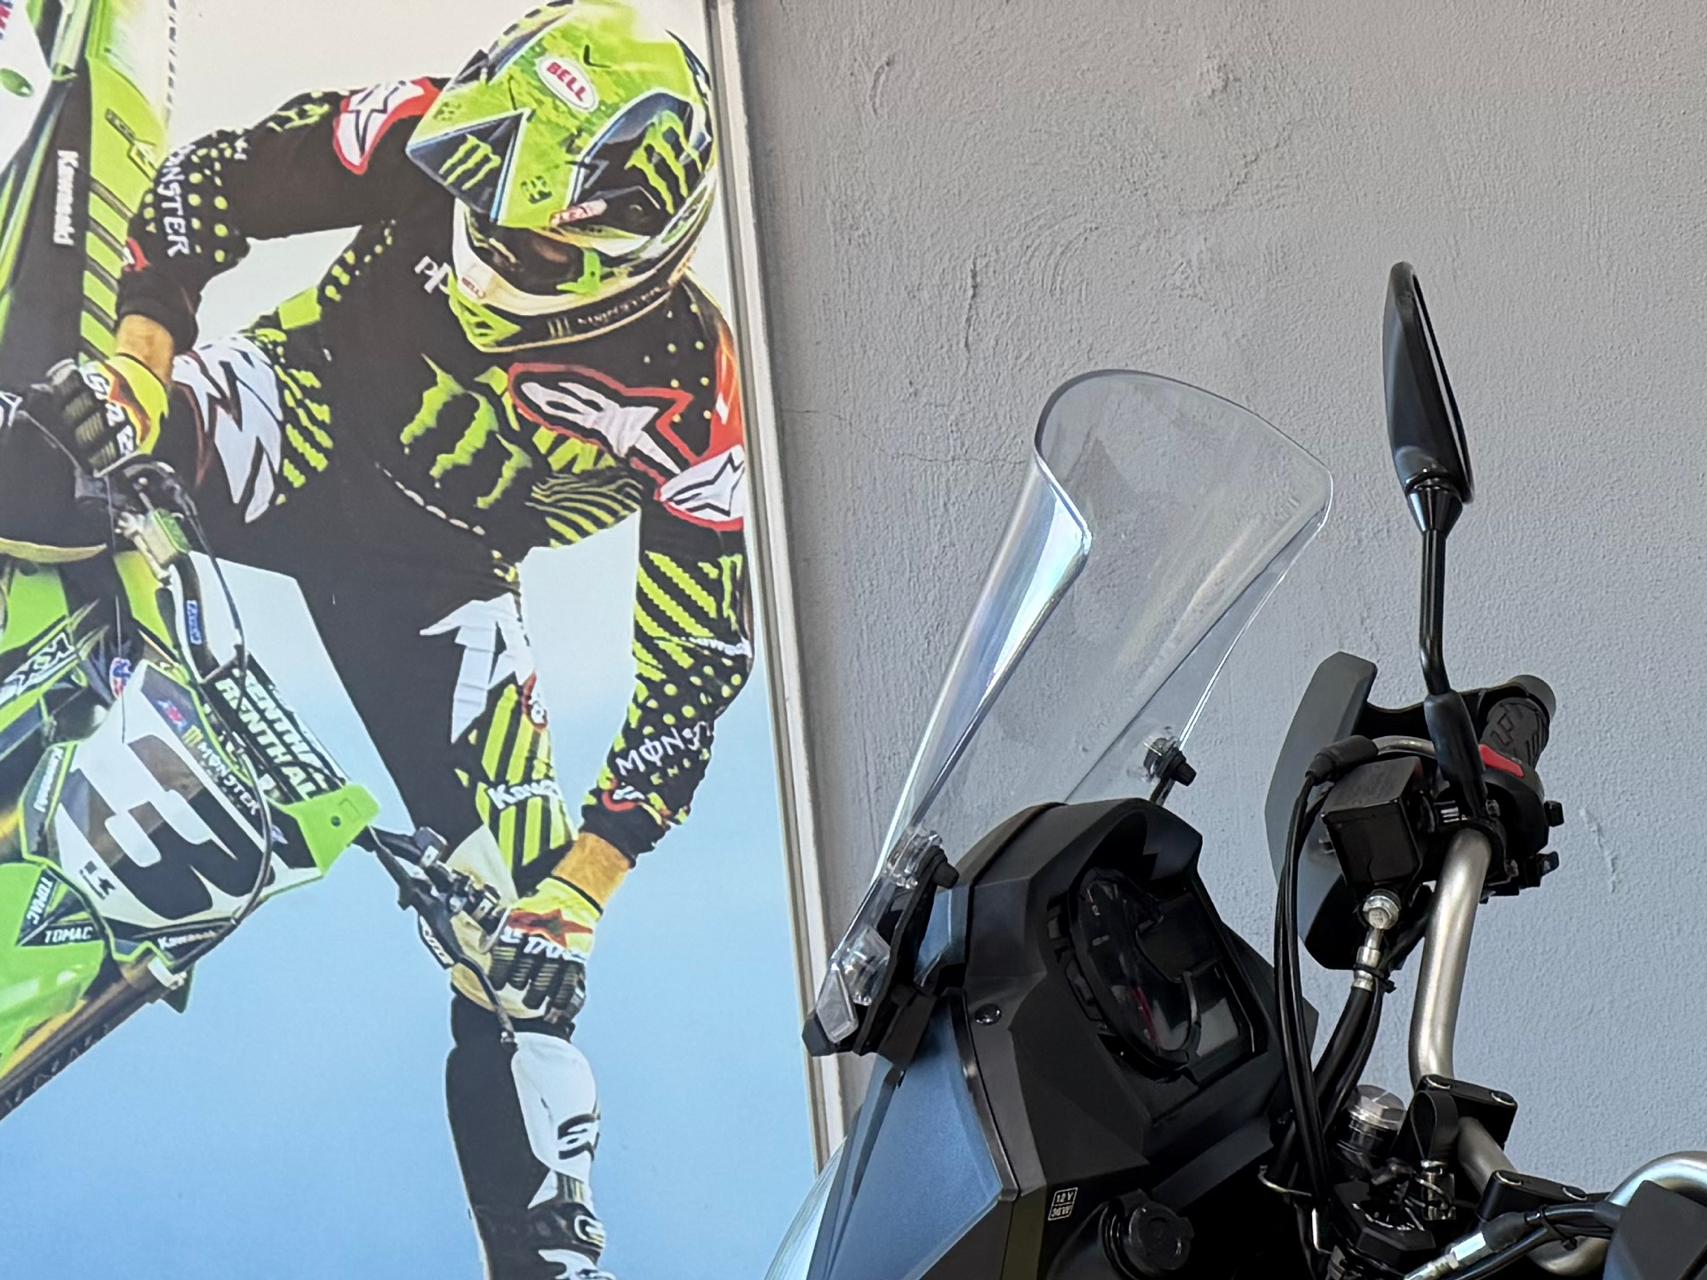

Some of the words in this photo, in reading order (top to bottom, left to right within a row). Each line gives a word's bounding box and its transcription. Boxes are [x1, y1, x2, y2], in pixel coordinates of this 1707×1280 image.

[547, 61, 588, 103] BELL
[27, 877, 52, 925] TOMAC
[44, 926, 94, 943] TOMAC
